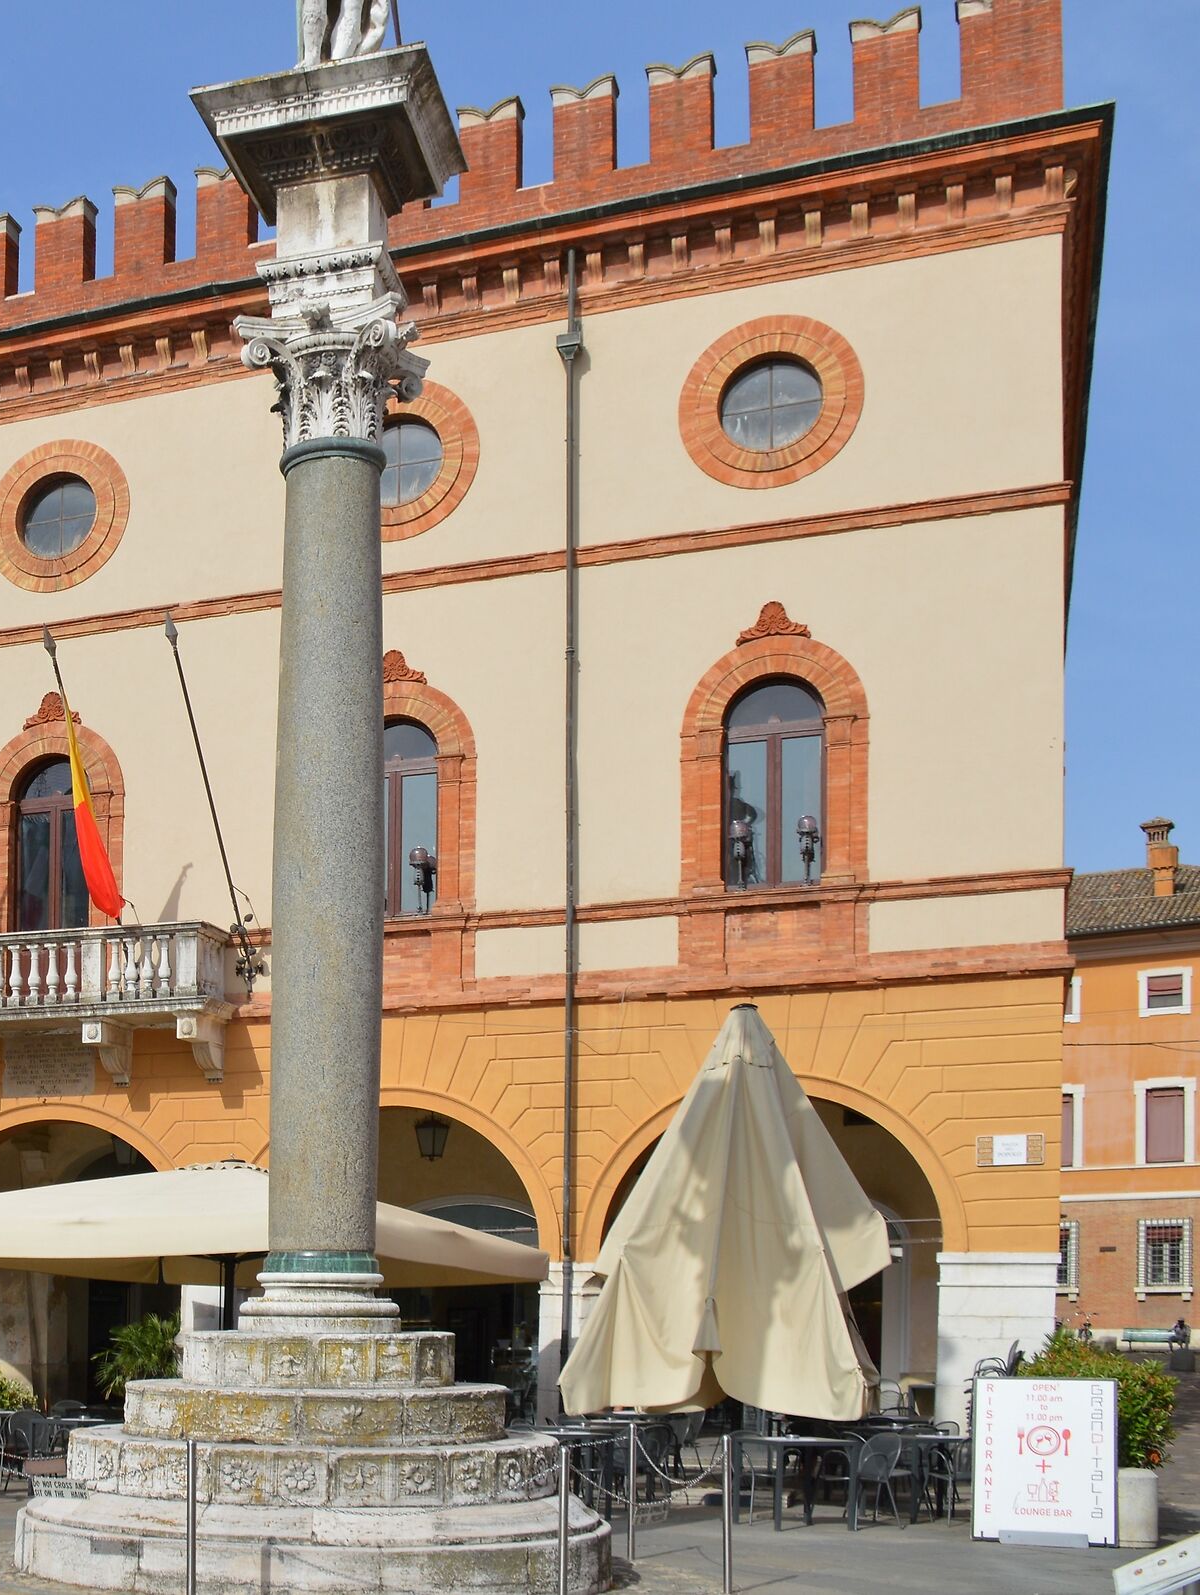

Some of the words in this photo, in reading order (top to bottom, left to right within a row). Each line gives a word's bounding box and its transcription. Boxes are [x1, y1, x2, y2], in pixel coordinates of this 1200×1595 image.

[1032, 1383, 1057, 1392] OPEN
[1026, 1394, 1047, 1402] 11.00
[1040, 1403, 1048, 1411] to
[1026, 1413, 1047, 1421] 11.00
[1049, 1414, 1063, 1423] pm
[984, 1383, 994, 1513] RISTORANTE
[42, 1480, 53, 1489] NOT
[54, 1481, 73, 1490] CROSS
[44, 1490, 53, 1498] ON
[54, 1490, 65, 1498] THE
[1014, 1508, 1051, 1517] LOUNGE
[1053, 1508, 1072, 1517] BAR
